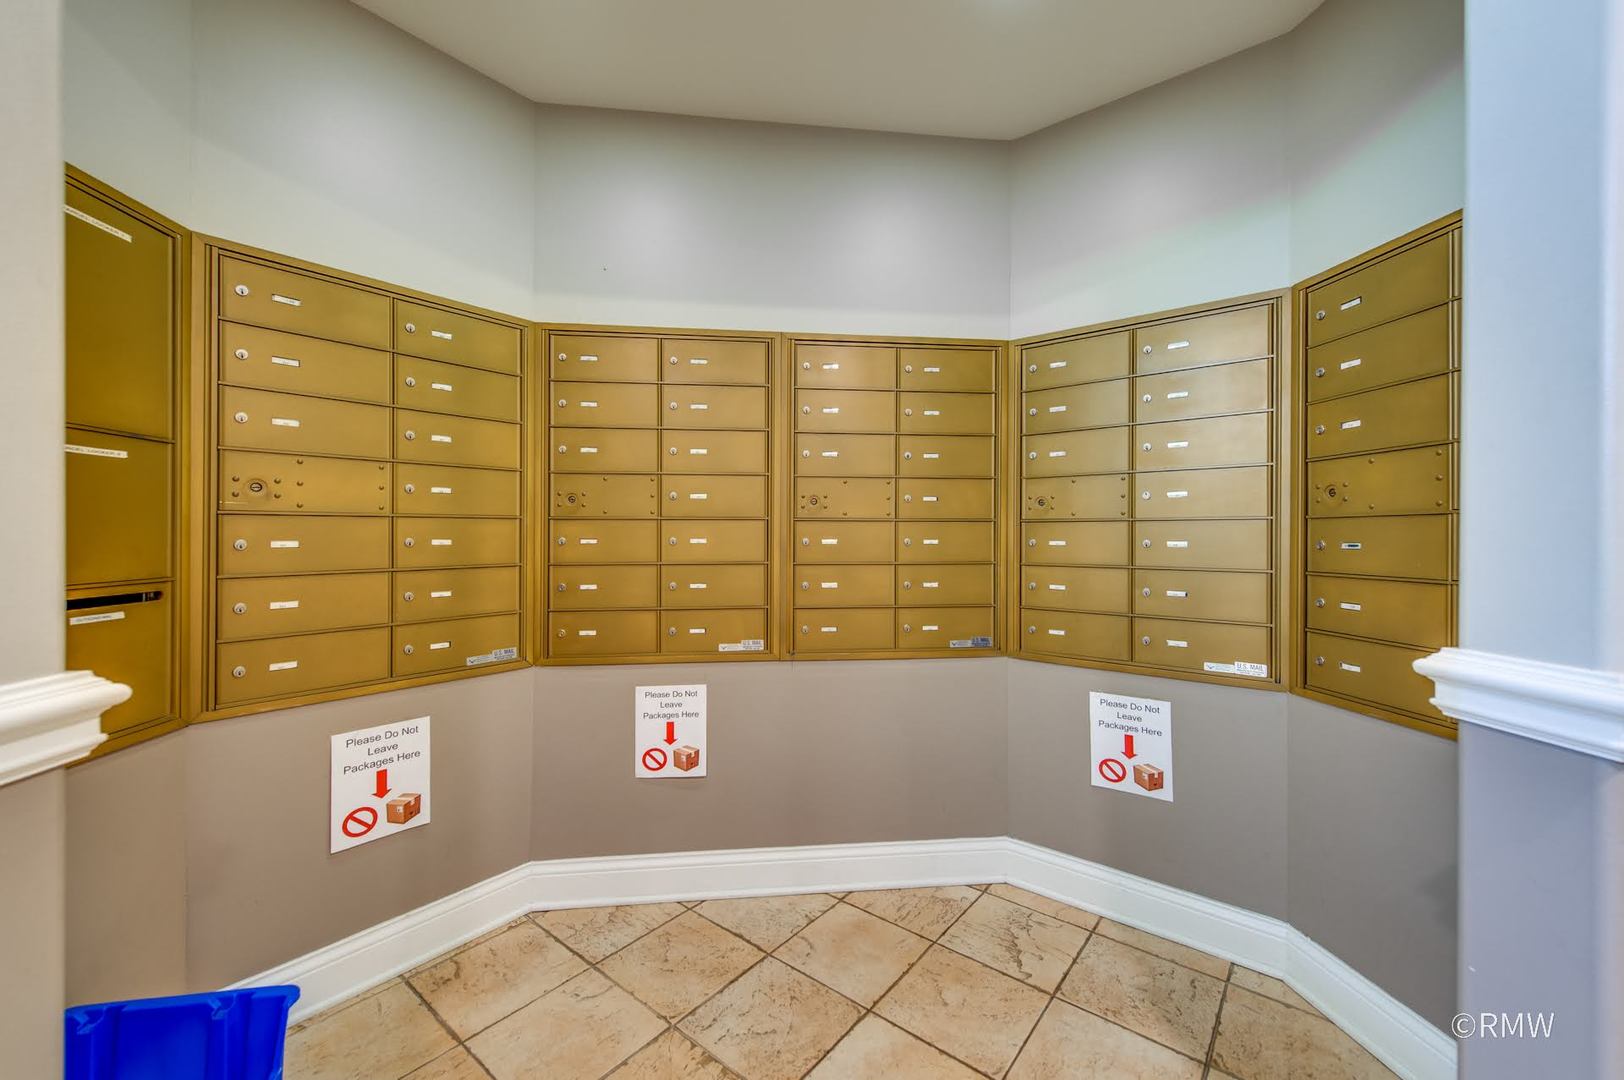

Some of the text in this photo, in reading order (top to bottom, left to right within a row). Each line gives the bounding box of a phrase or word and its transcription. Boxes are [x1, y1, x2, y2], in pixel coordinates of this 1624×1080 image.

[672, 690, 683, 698] Do
[1099, 698, 1160, 714] Please Do Not
[643, 710, 700, 720] Packages Here
[1116, 711, 1143, 722] Leave
[1098, 720, 1163, 737] Packages Here
[345, 725, 419, 749] Please Do Not
[367, 743, 399, 756] Leave
[343, 750, 421, 775] Packages Here
